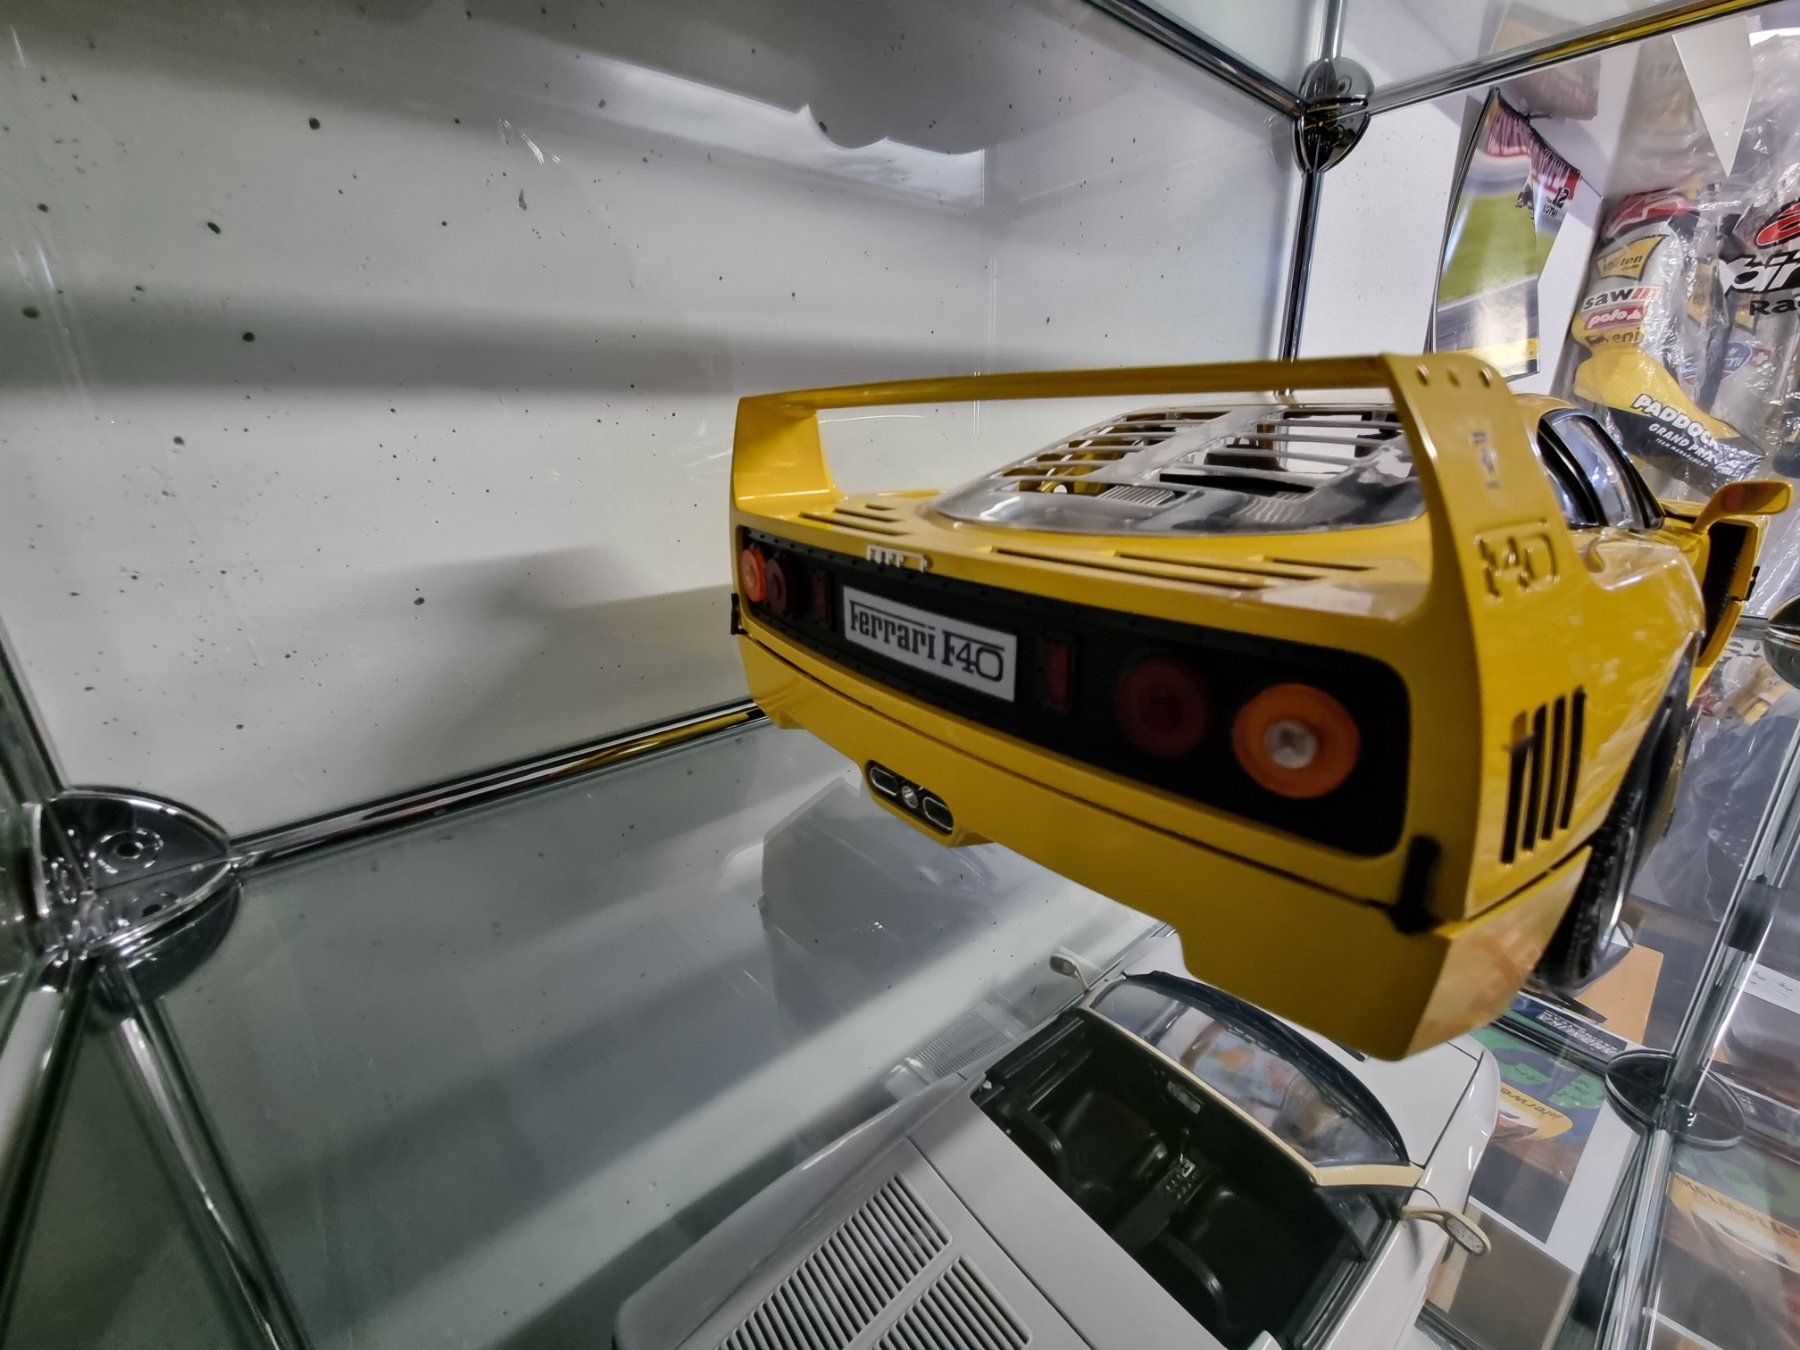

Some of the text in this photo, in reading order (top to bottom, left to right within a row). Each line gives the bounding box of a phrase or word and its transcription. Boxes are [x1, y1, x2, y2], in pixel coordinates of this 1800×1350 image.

[1750, 298, 1800, 316] Ra
[1587, 308, 1628, 329] polo
[1648, 423, 1690, 447] GRAND
[850, 600, 1004, 682] Ferrari F40
